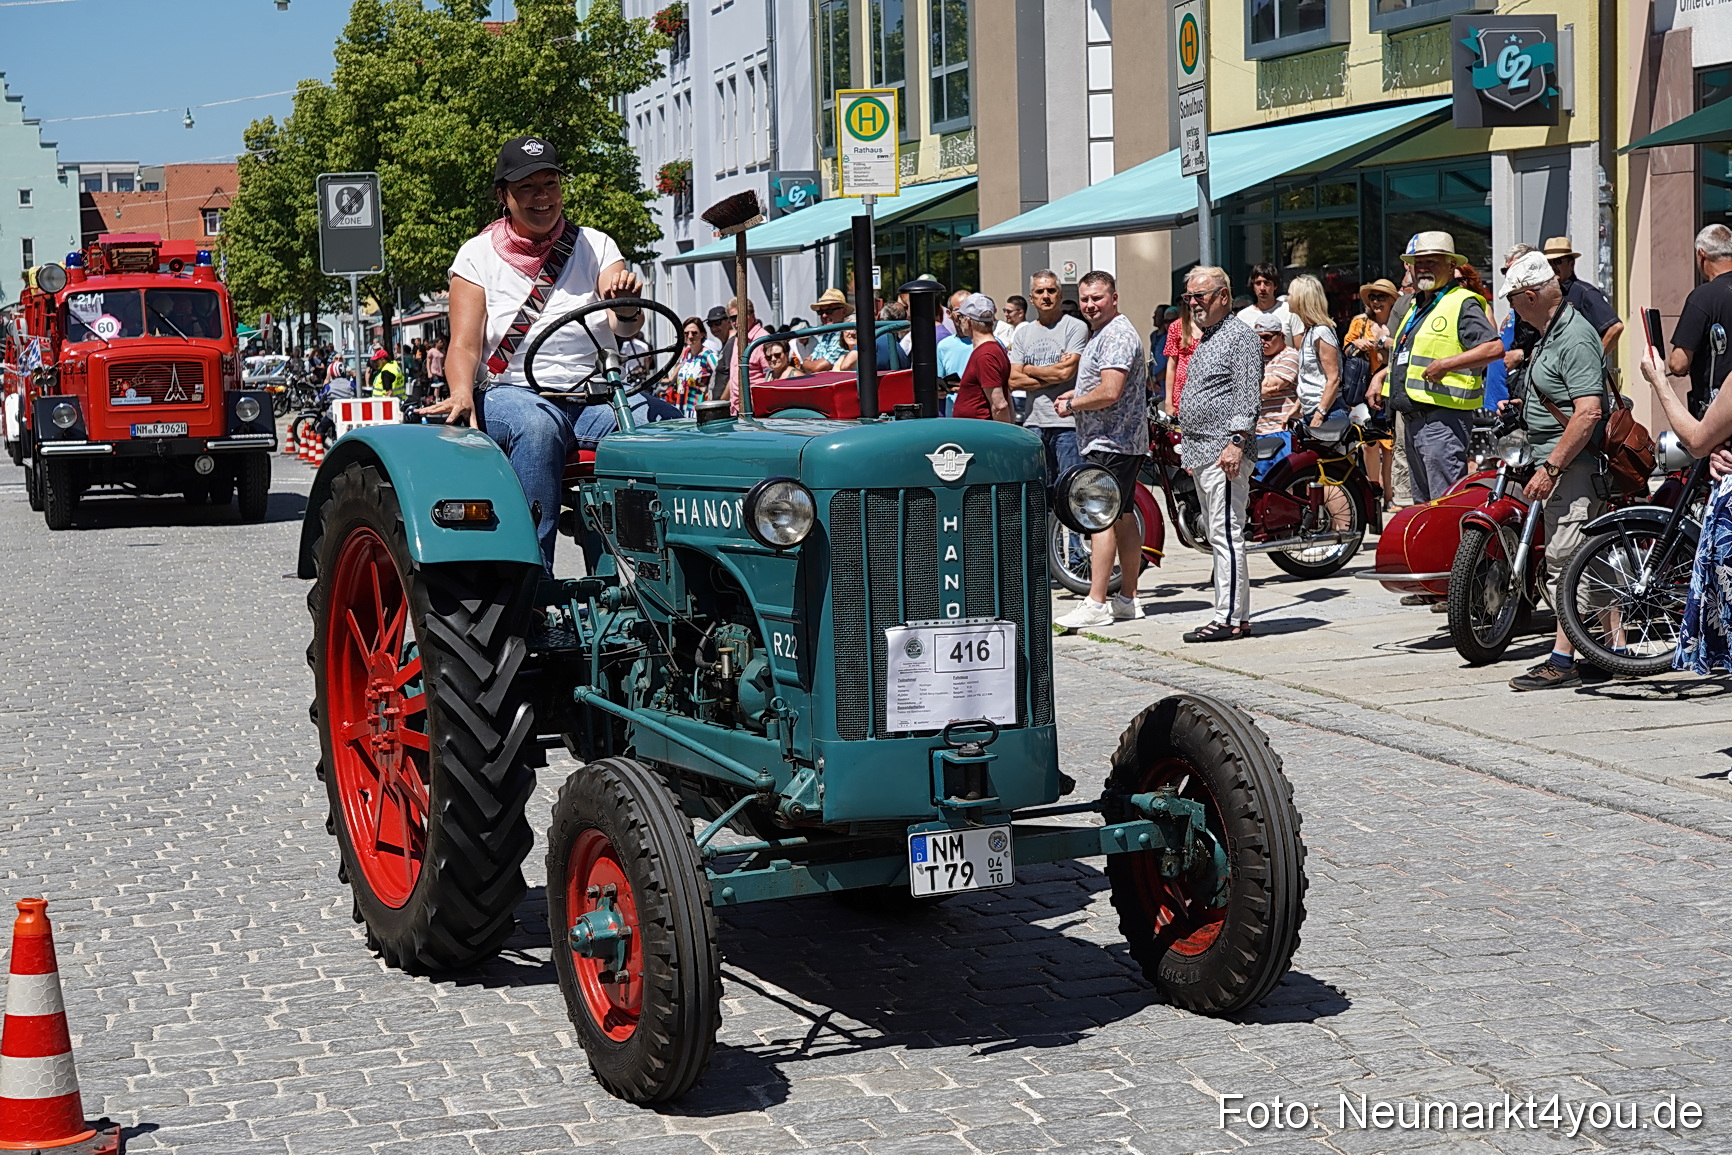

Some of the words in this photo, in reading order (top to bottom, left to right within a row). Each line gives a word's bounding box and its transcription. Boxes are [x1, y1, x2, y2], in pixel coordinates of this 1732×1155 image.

[1496, 44, 1532, 91] G2
[1180, 97, 1204, 119] Schulbus
[858, 107, 877, 132] H
[853, 146, 883, 154] Rathaus
[788, 185, 807, 208] G2
[339, 216, 362, 225] ZONE
[77, 293, 104, 305] 21/1
[97, 321, 114, 334] 60
[136, 425, 148, 434] NM
[152, 425, 159, 434] R
[160, 424, 186, 433] 1962H
[949, 639, 990, 664] 416
[932, 834, 964, 862] NM
[916, 852, 923, 861] D
[988, 857, 1003, 869] 04
[989, 872, 1004, 884] 10
